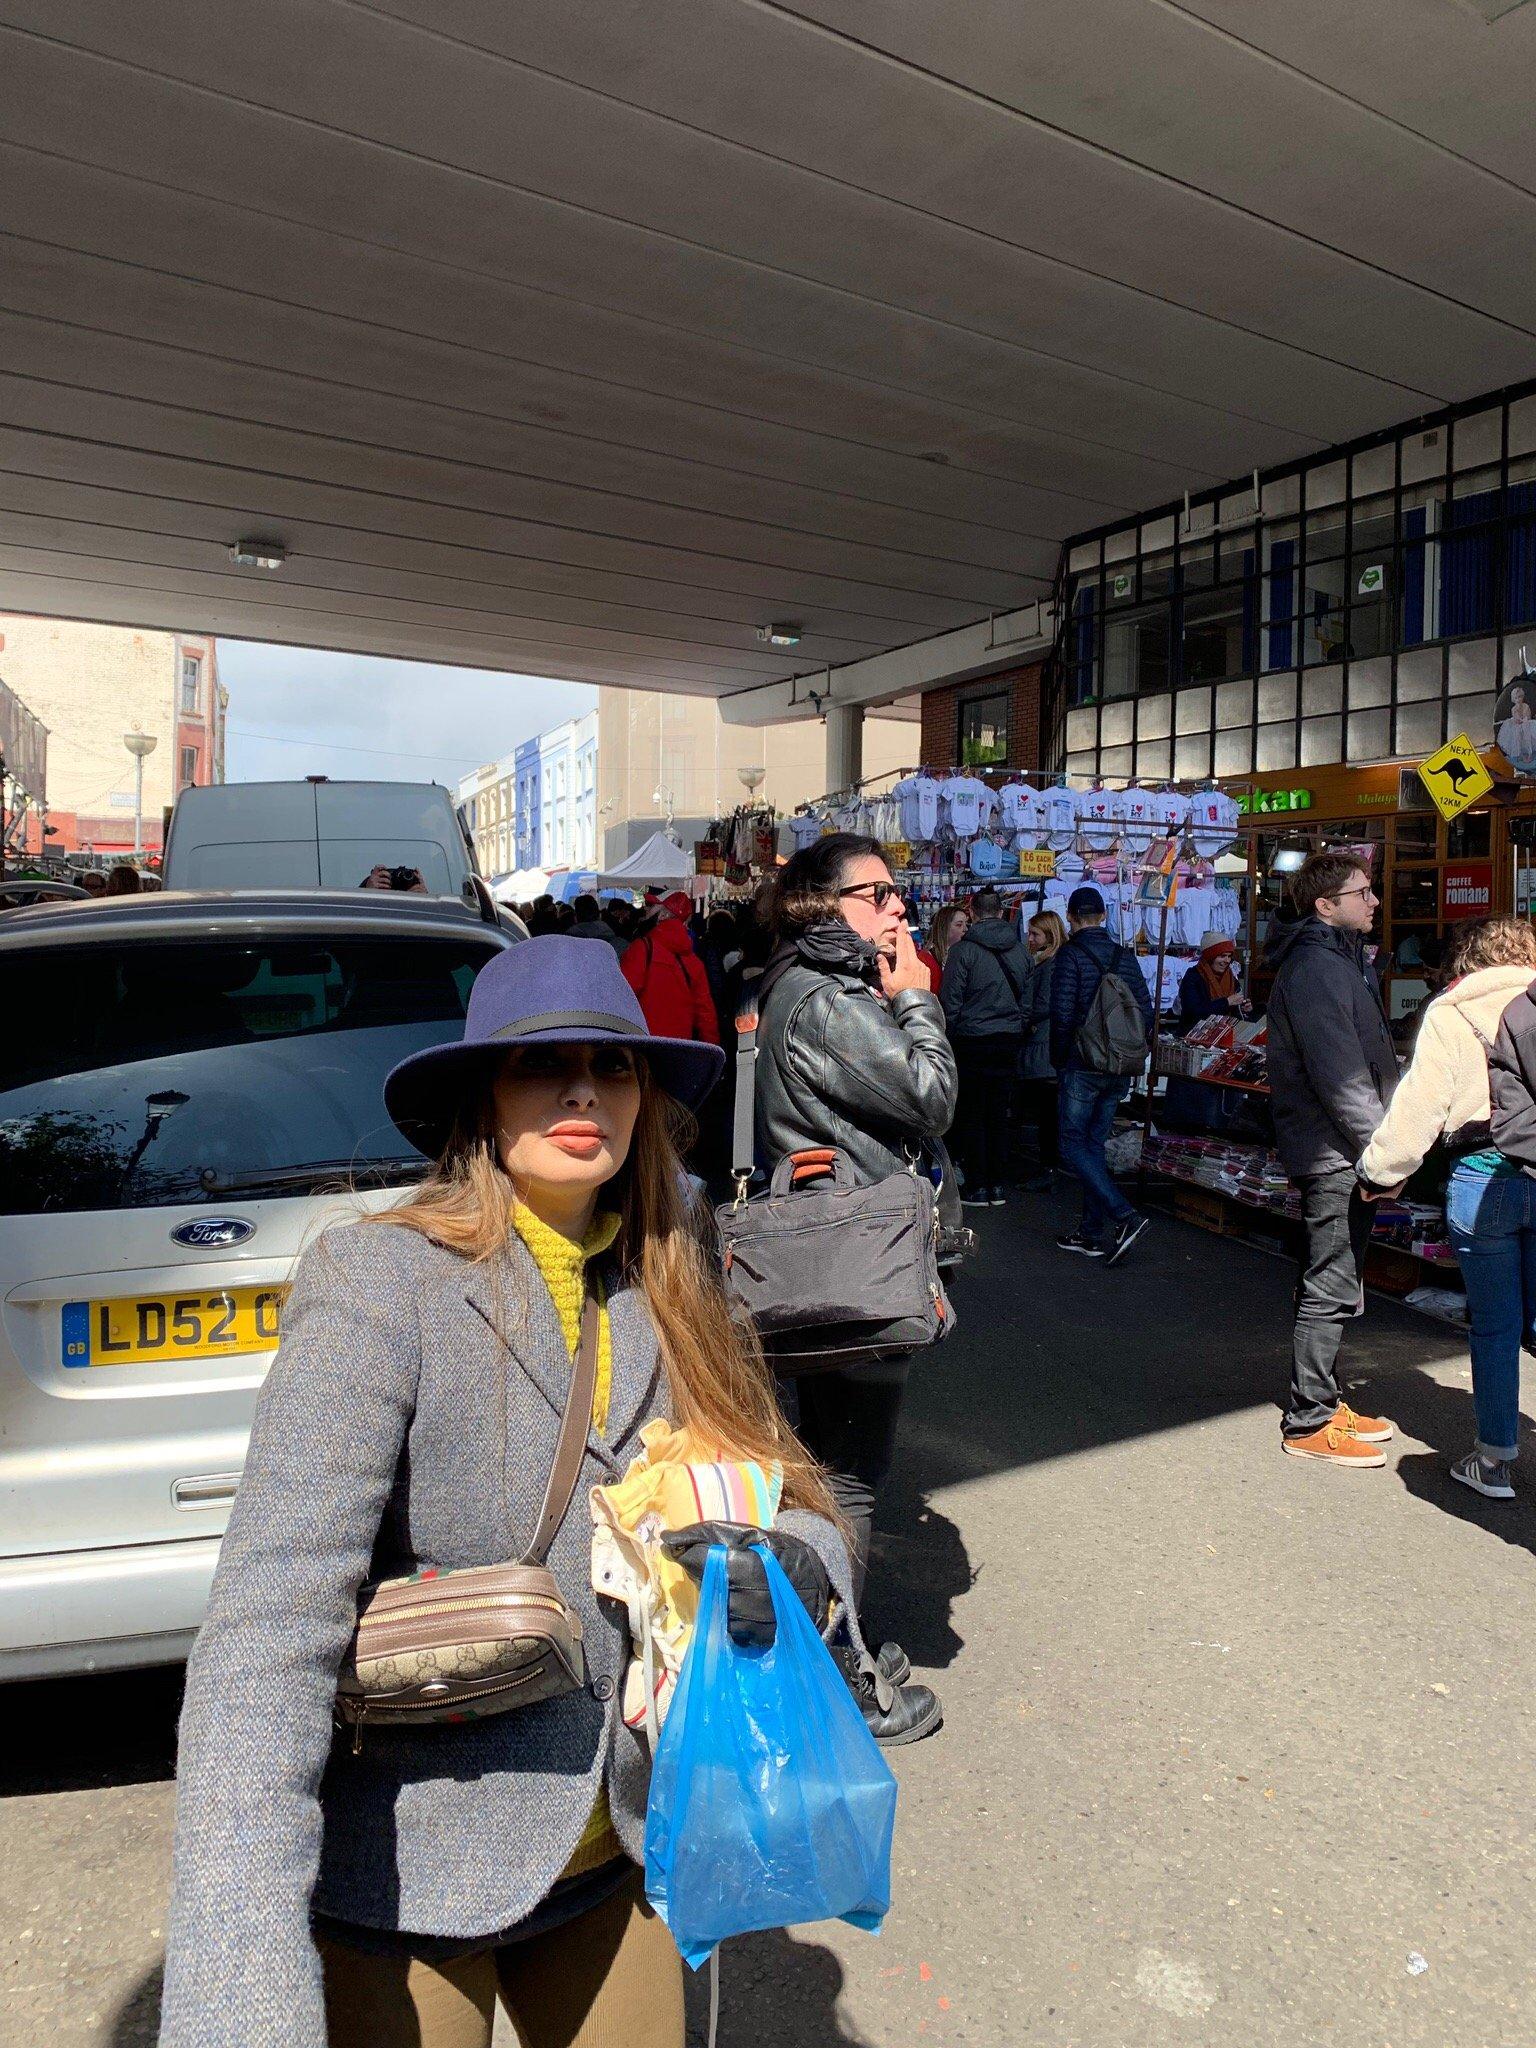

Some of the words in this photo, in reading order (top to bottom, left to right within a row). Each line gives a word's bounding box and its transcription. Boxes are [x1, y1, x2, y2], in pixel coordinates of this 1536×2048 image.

[1450, 744, 1473, 757] NEXT
[1439, 796, 1462, 808] 12KM
[1446, 877, 1472, 887] COFFEE
[1446, 886, 1490, 905] romana
[188, 1221, 235, 1242] Ford
[100, 1295, 238, 1353] LD52
[67, 1342, 86, 1356] GB
